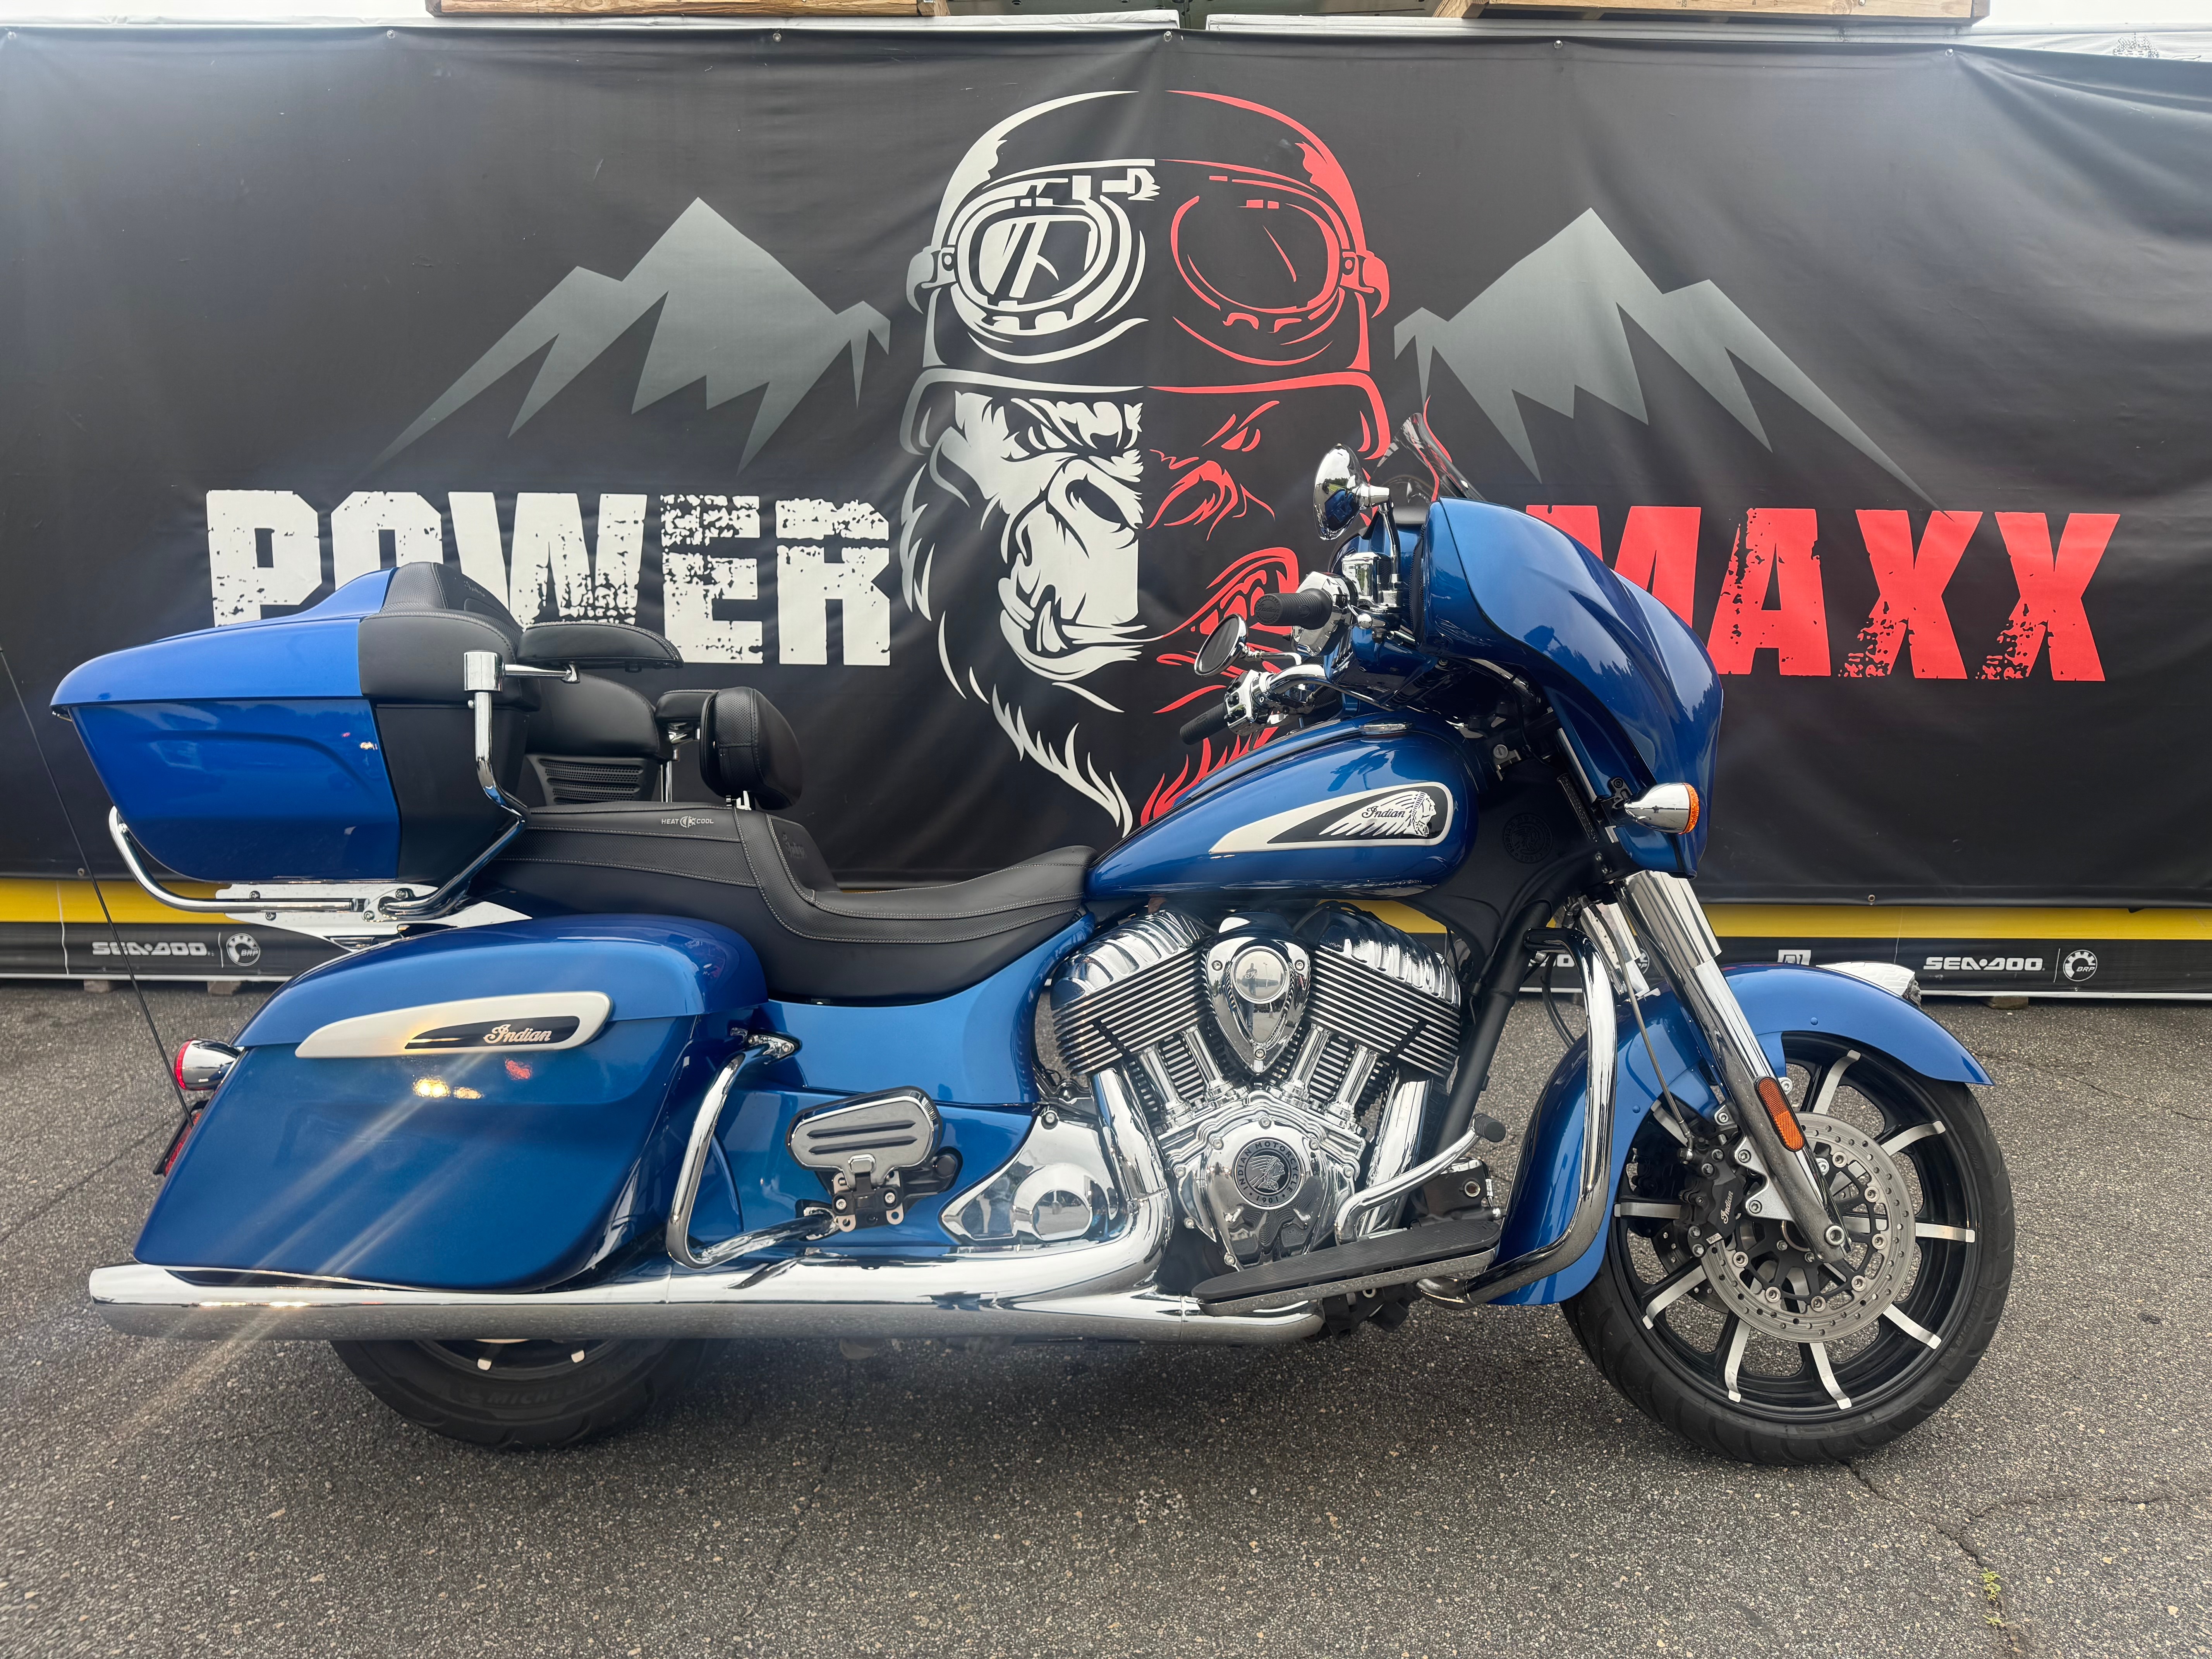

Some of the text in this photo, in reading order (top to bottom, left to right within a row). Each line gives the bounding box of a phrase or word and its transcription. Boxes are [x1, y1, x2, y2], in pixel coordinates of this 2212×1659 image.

[1362, 805, 1405, 818] Indian
[483, 1024, 552, 1044] Indian
[1238, 1141, 1298, 1193] INDIAN MOTORCYCLE
[1721, 1190, 1733, 1224] Indian
[1955, 1292, 1983, 1347] MICHELIN
